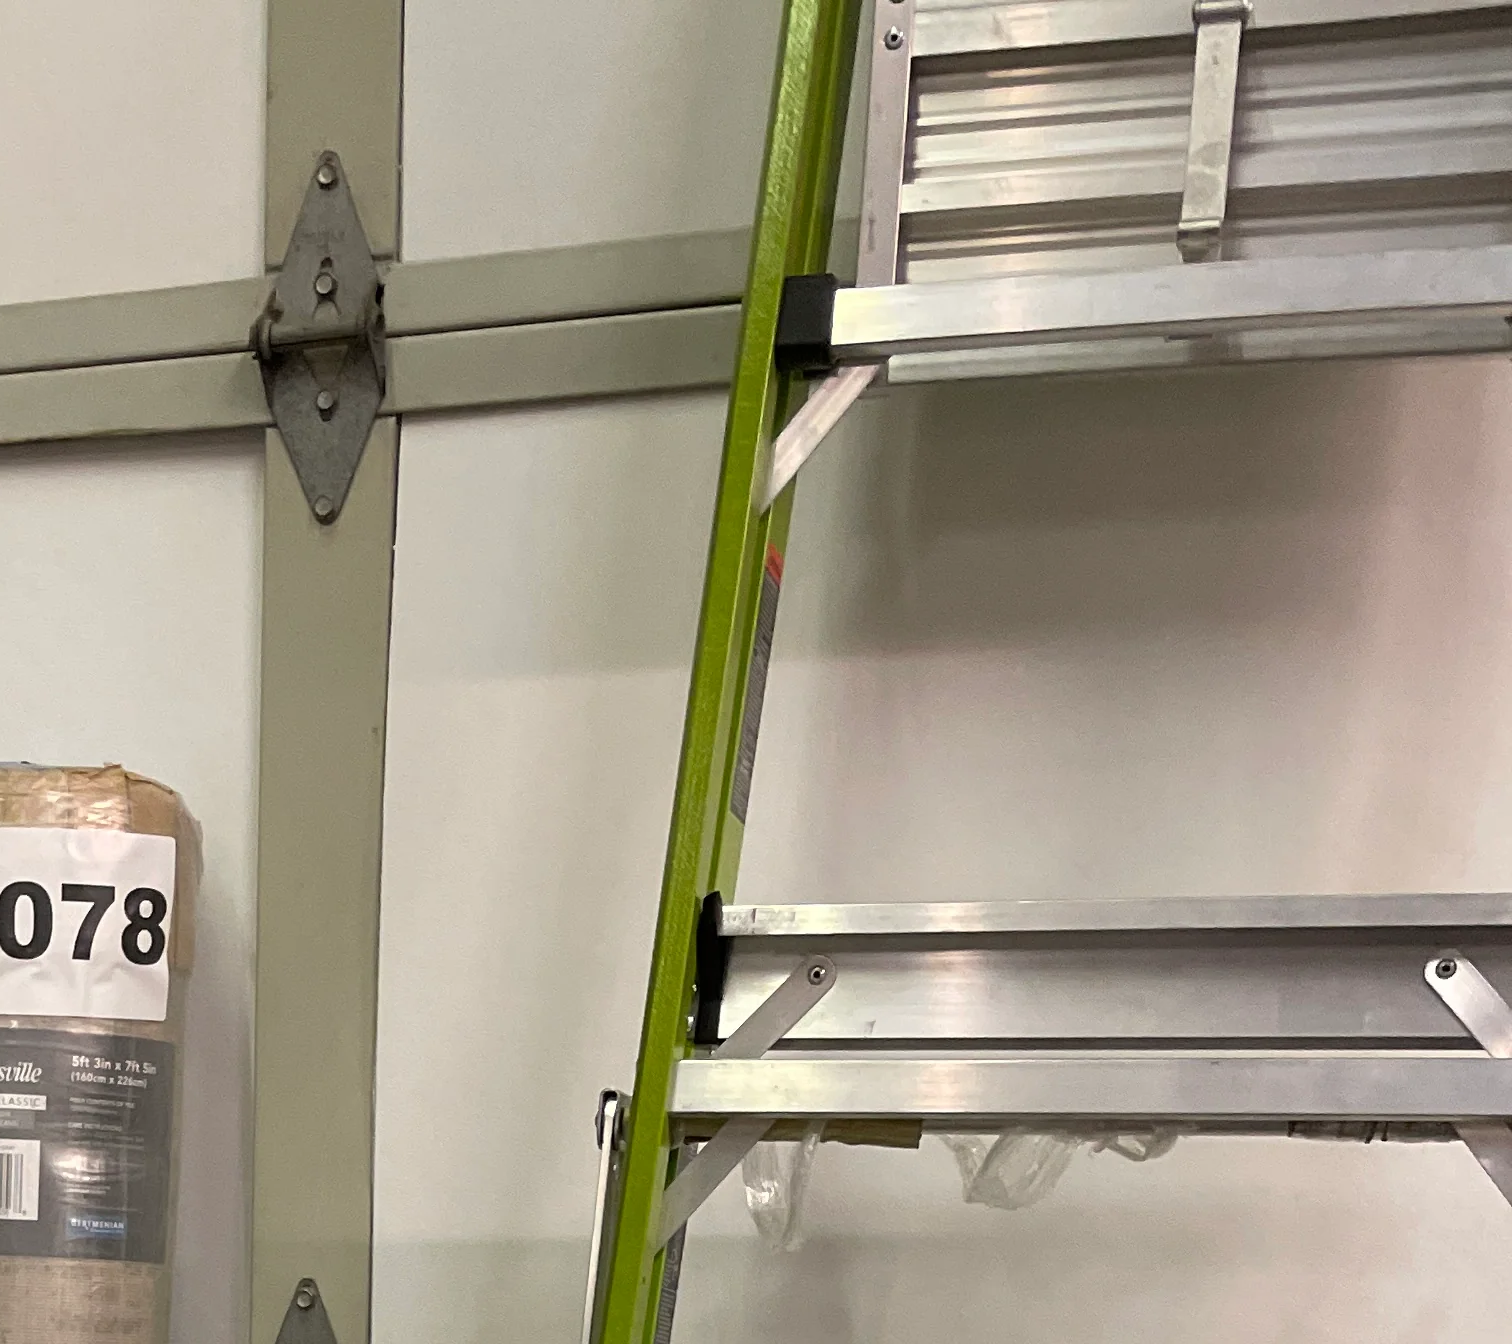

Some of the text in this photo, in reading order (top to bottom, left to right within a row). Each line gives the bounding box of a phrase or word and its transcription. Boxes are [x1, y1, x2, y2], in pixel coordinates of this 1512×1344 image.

[71, 1055, 90, 1068] 5ft
[93, 1057, 111, 1070] 3in
[115, 1062, 122, 1071] x
[125, 1060, 140, 1073] 7ft
[108, 1077, 115, 1085] x
